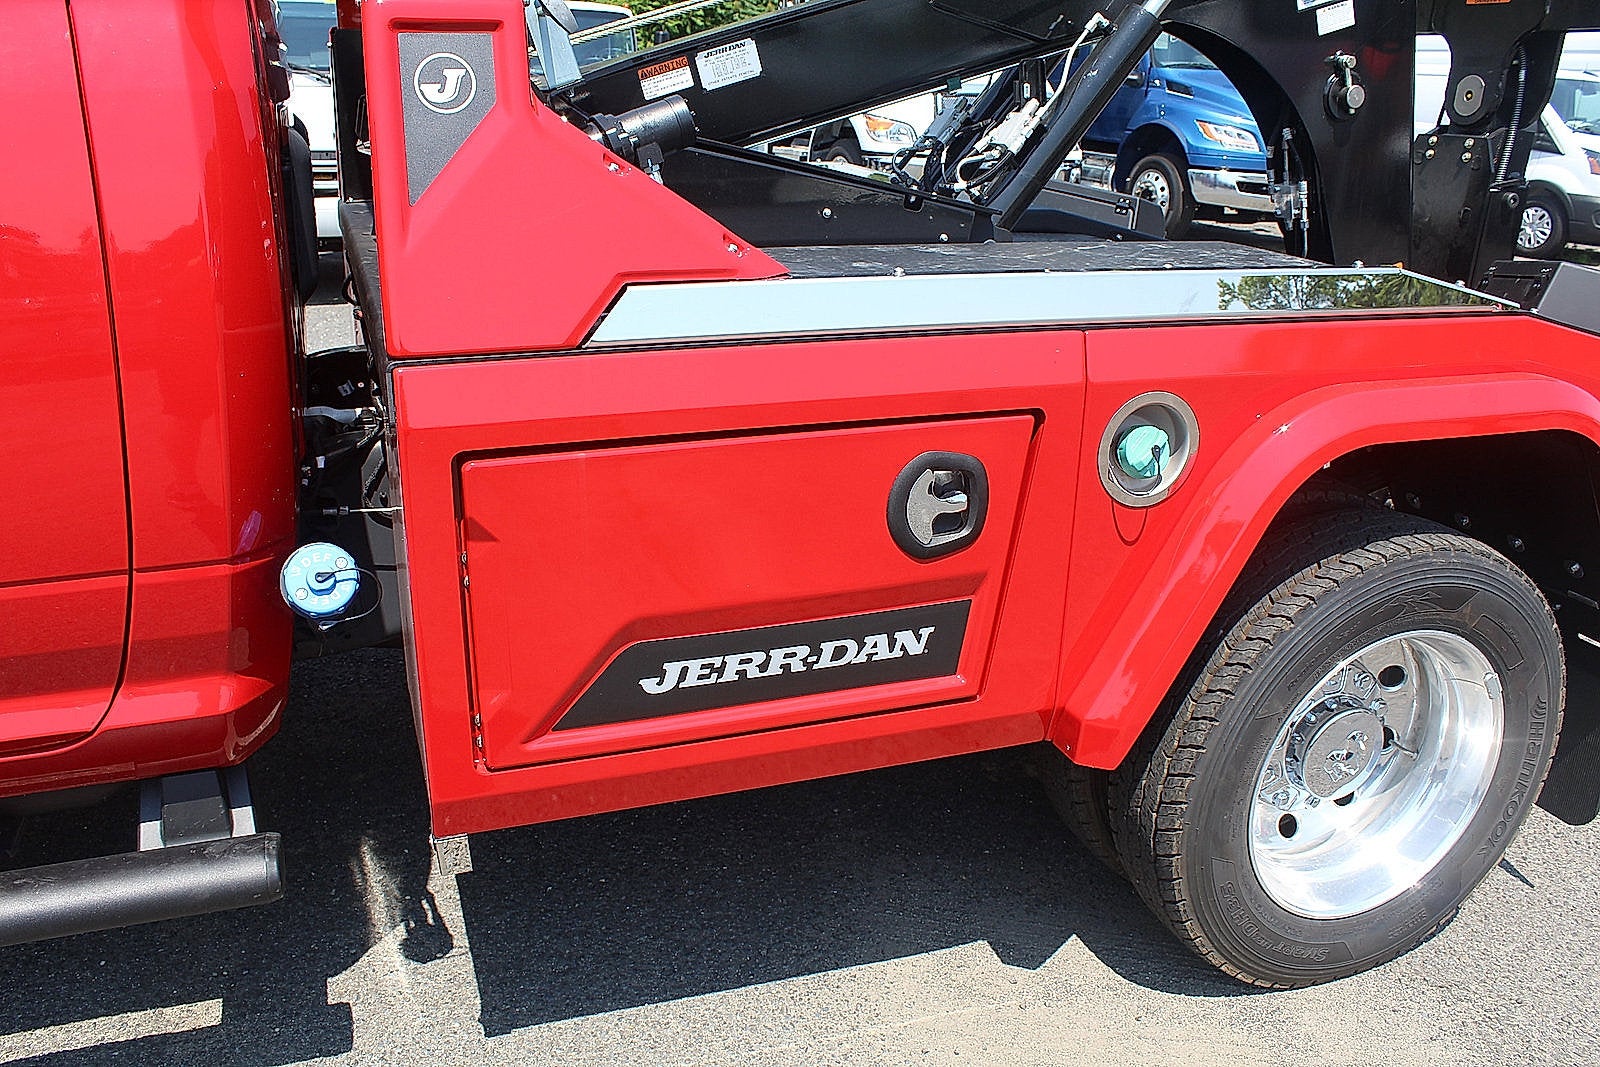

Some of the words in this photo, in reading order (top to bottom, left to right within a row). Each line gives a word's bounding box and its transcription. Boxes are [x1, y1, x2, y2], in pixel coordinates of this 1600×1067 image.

[647, 58, 688, 76] WARNING
[420, 68, 467, 104] J
[301, 552, 332, 568] DEF
[638, 626, 936, 695] JERR-DAN
